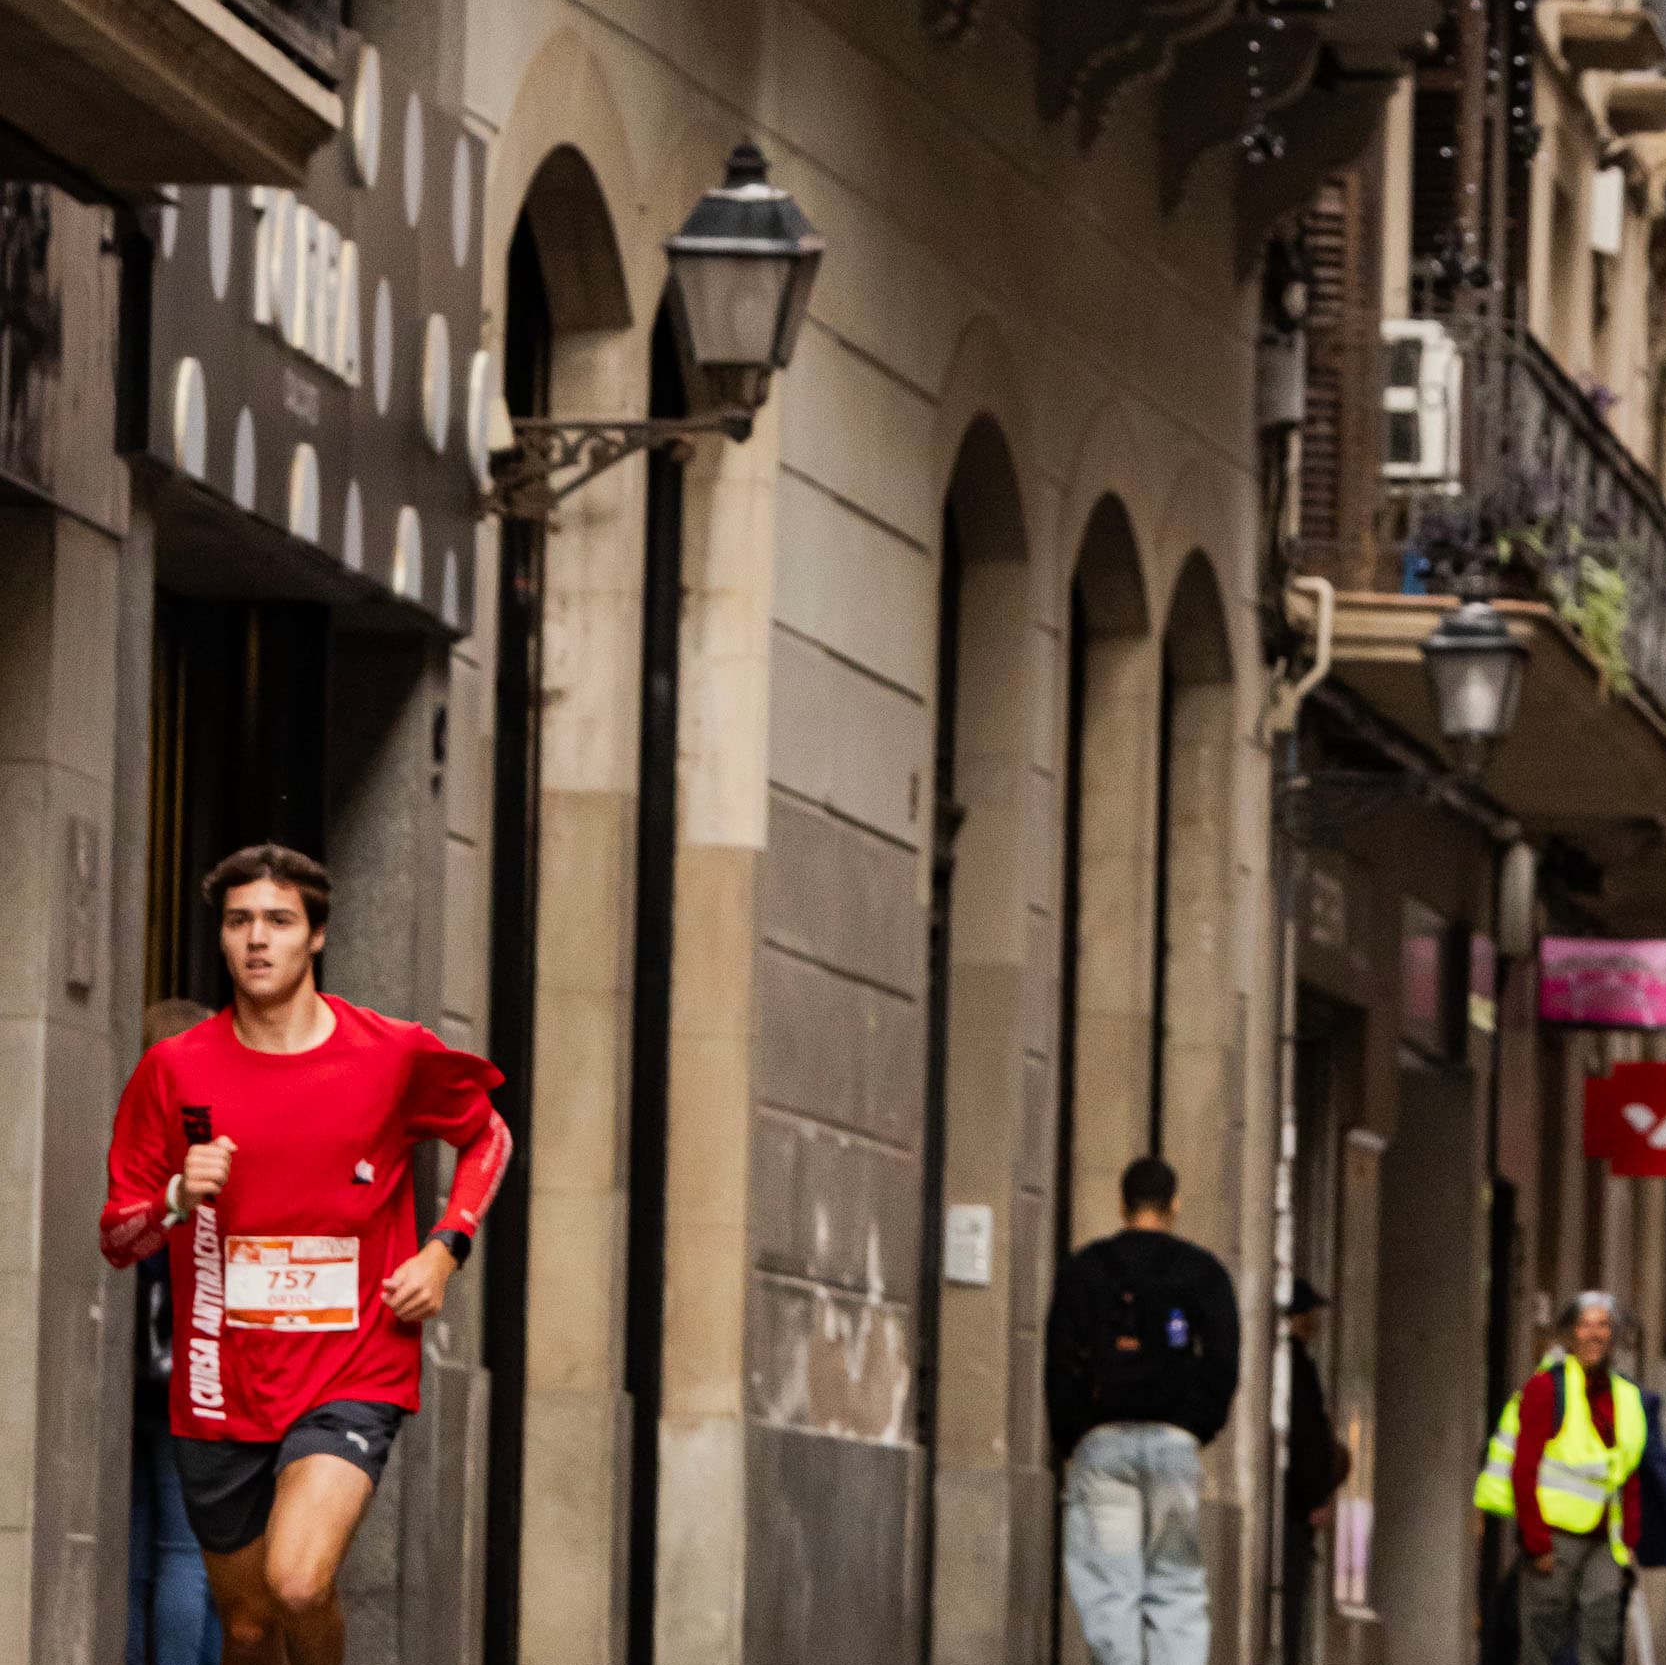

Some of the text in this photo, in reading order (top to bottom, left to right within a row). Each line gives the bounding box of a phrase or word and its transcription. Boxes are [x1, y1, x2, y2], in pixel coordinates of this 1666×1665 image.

[192, 1203, 224, 1338] ANTIRACISTA
[267, 1270, 317, 1290] 757
[188, 1338, 226, 1408] CURSA
